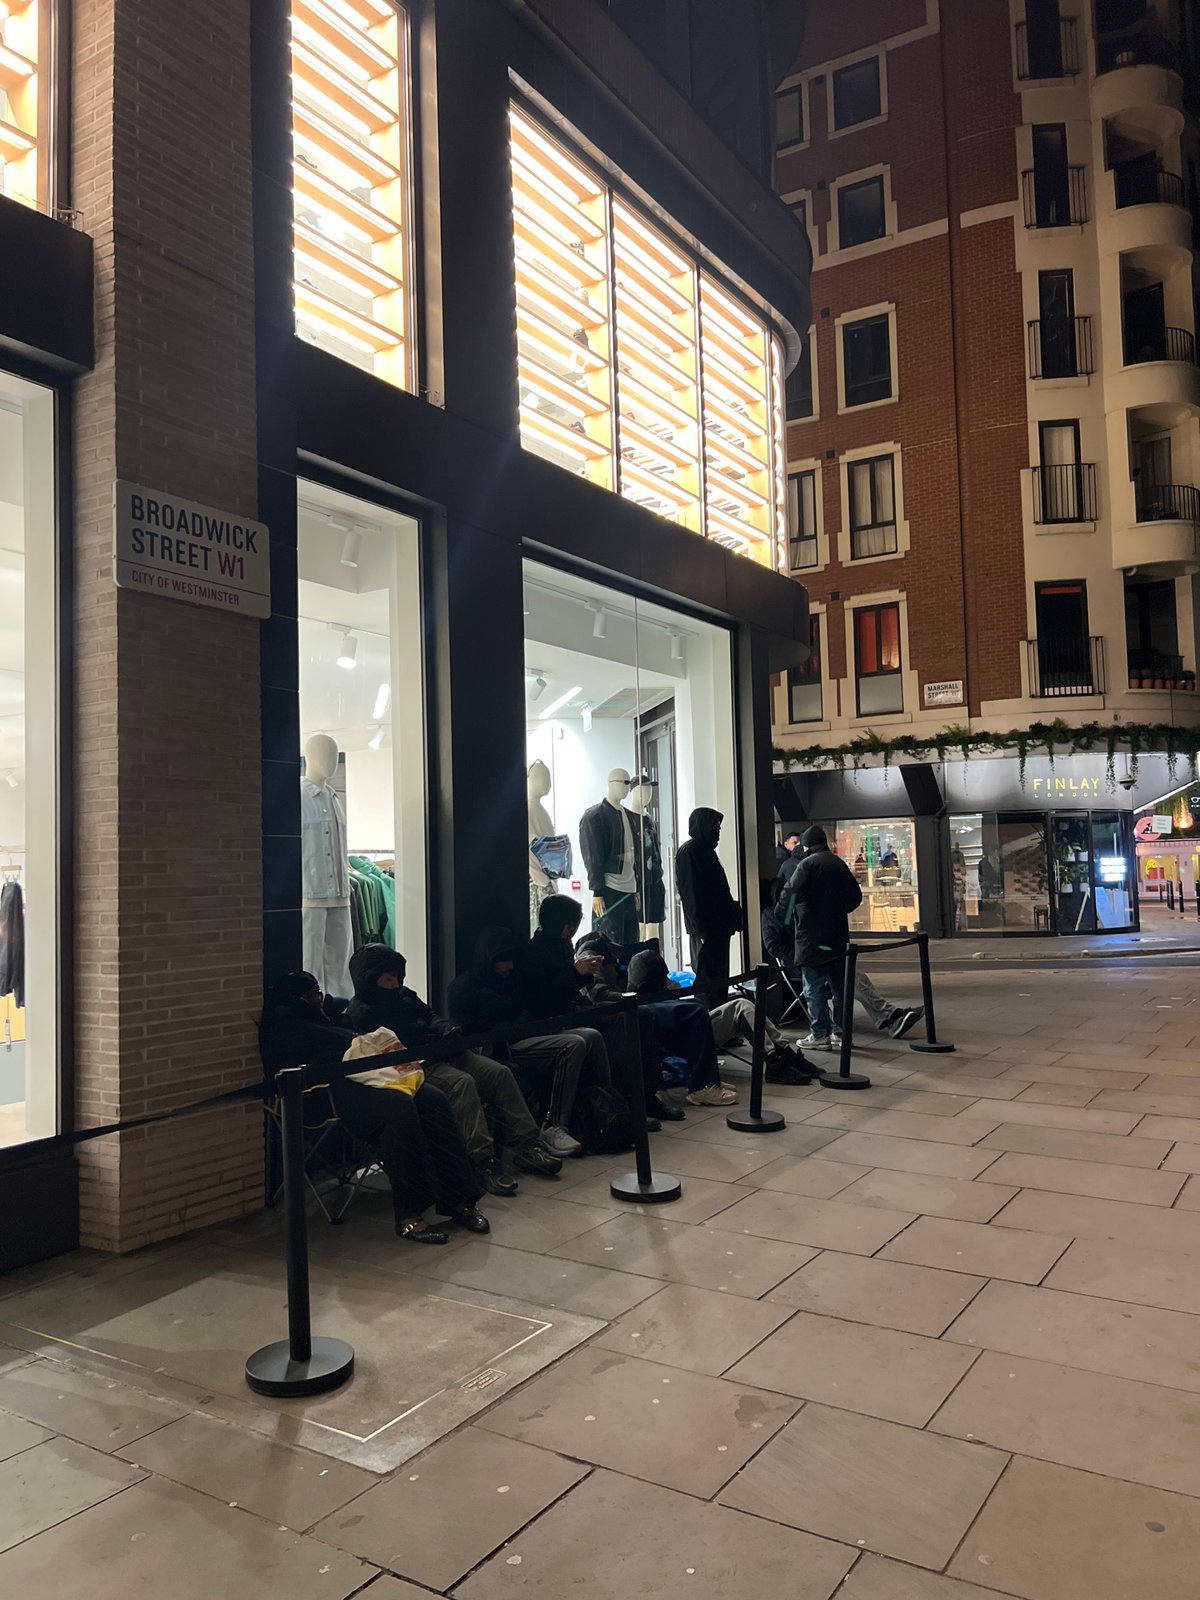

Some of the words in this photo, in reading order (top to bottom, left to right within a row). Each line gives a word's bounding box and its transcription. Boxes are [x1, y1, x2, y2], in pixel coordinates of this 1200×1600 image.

[131, 494, 258, 554] BROADWICK
[131, 527, 212, 571] STREET
[217, 551, 244, 580] W1
[132, 570, 155, 585] CITY
[157, 576, 169, 589] OF
[172, 579, 240, 606] WESTMINSTER
[927, 683, 959, 691] MARSHALL
[1033, 778, 1100, 790] FINLAY
